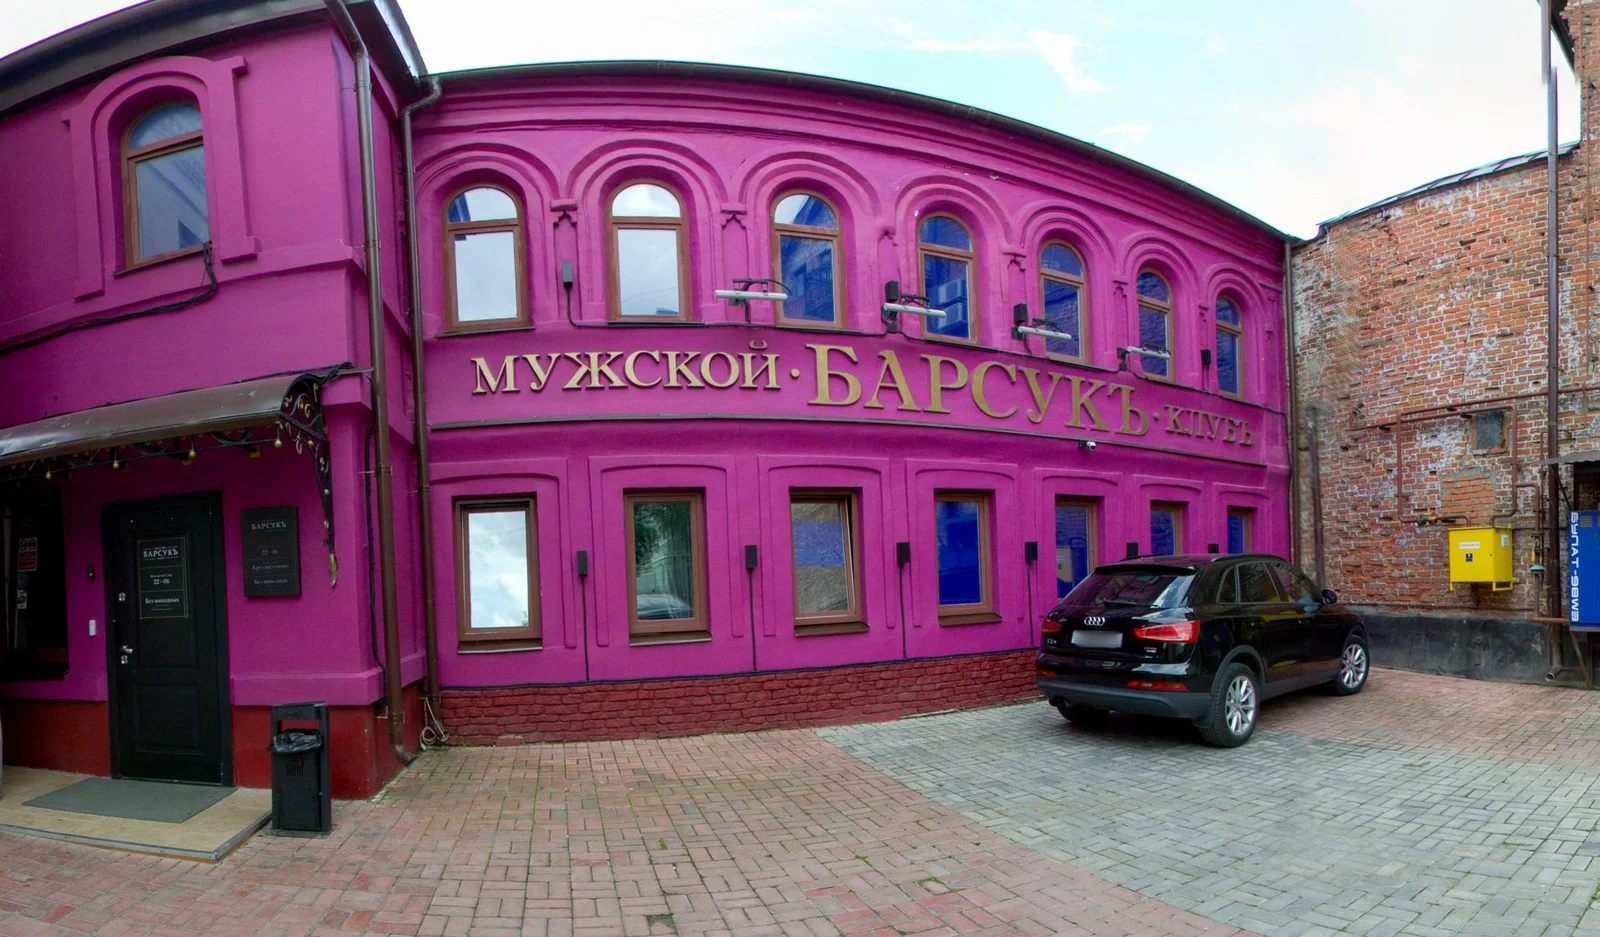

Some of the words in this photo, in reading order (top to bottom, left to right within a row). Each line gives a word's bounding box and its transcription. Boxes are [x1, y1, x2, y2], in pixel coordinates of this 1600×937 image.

[471, 339, 781, 395] МУЖСКОЙ
[806, 343, 1150, 437] БАРСУКЪ
[1164, 404, 1255, 446] КЛУБЪ
[251, 521, 288, 531] БАРСУКЪ
[143, 548, 179, 558] БАРСУКЪ
